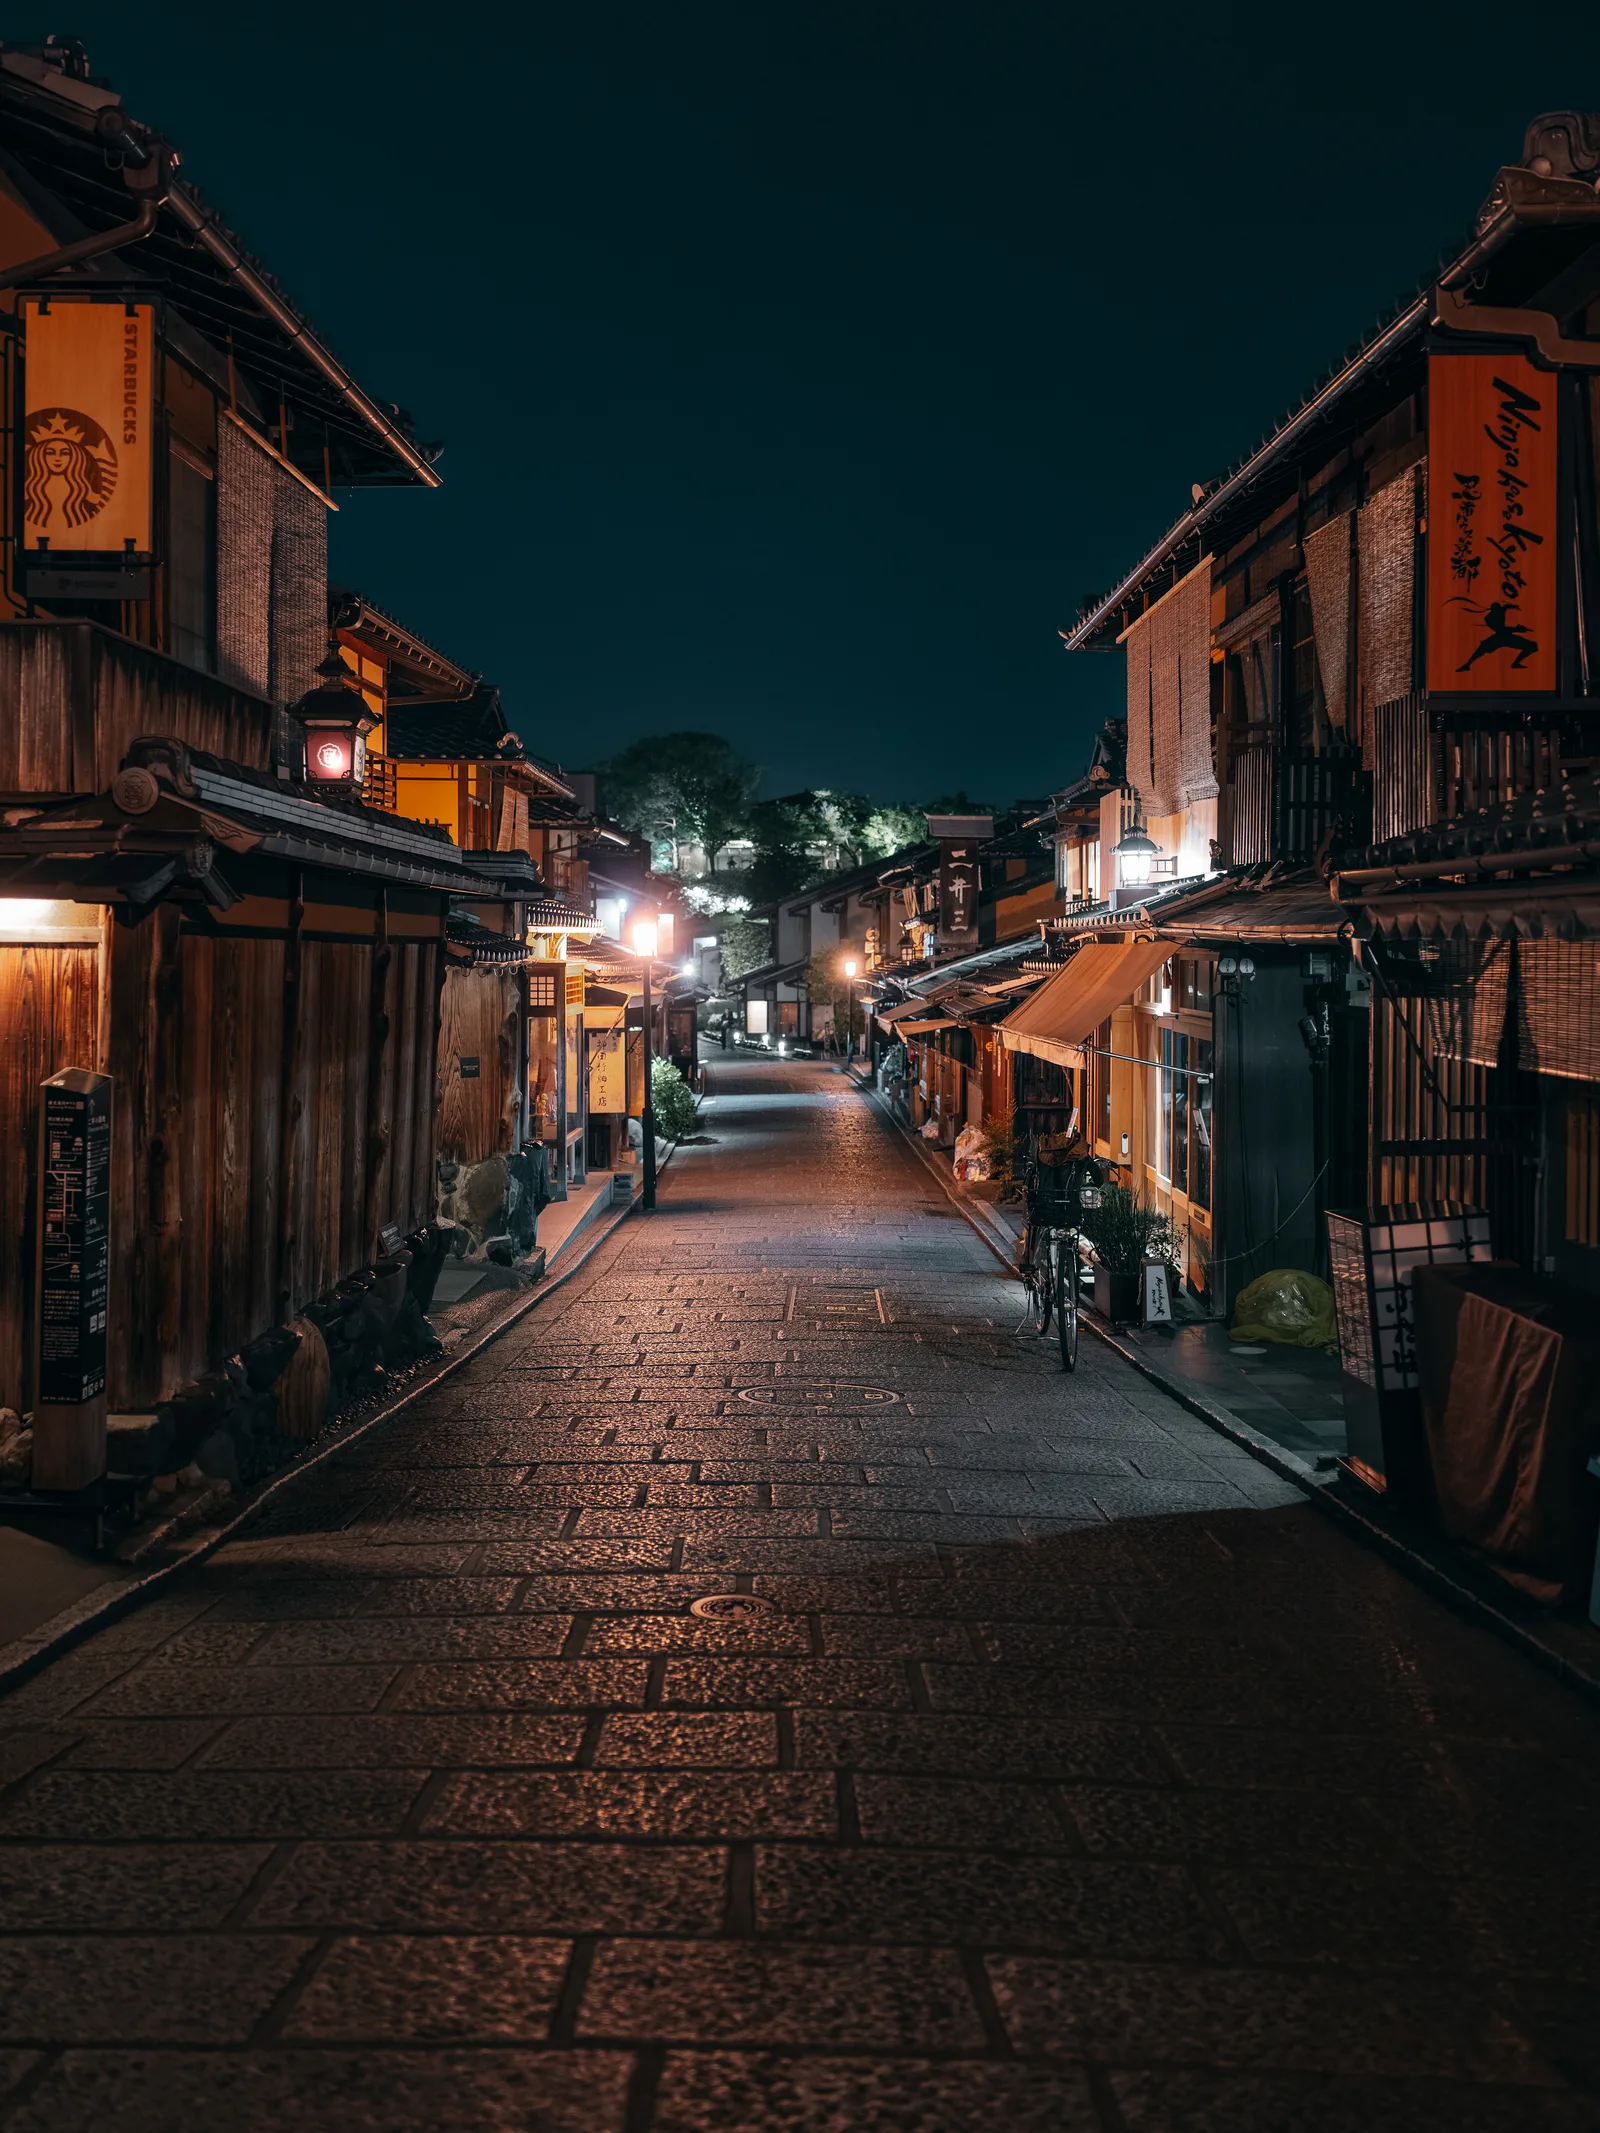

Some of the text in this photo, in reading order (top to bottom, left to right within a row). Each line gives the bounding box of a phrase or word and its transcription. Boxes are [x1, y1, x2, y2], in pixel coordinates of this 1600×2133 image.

[123, 323, 138, 446] STARBUCKS
[1484, 376, 1541, 467] Ninja
[1486, 523, 1544, 599] Kyoto
